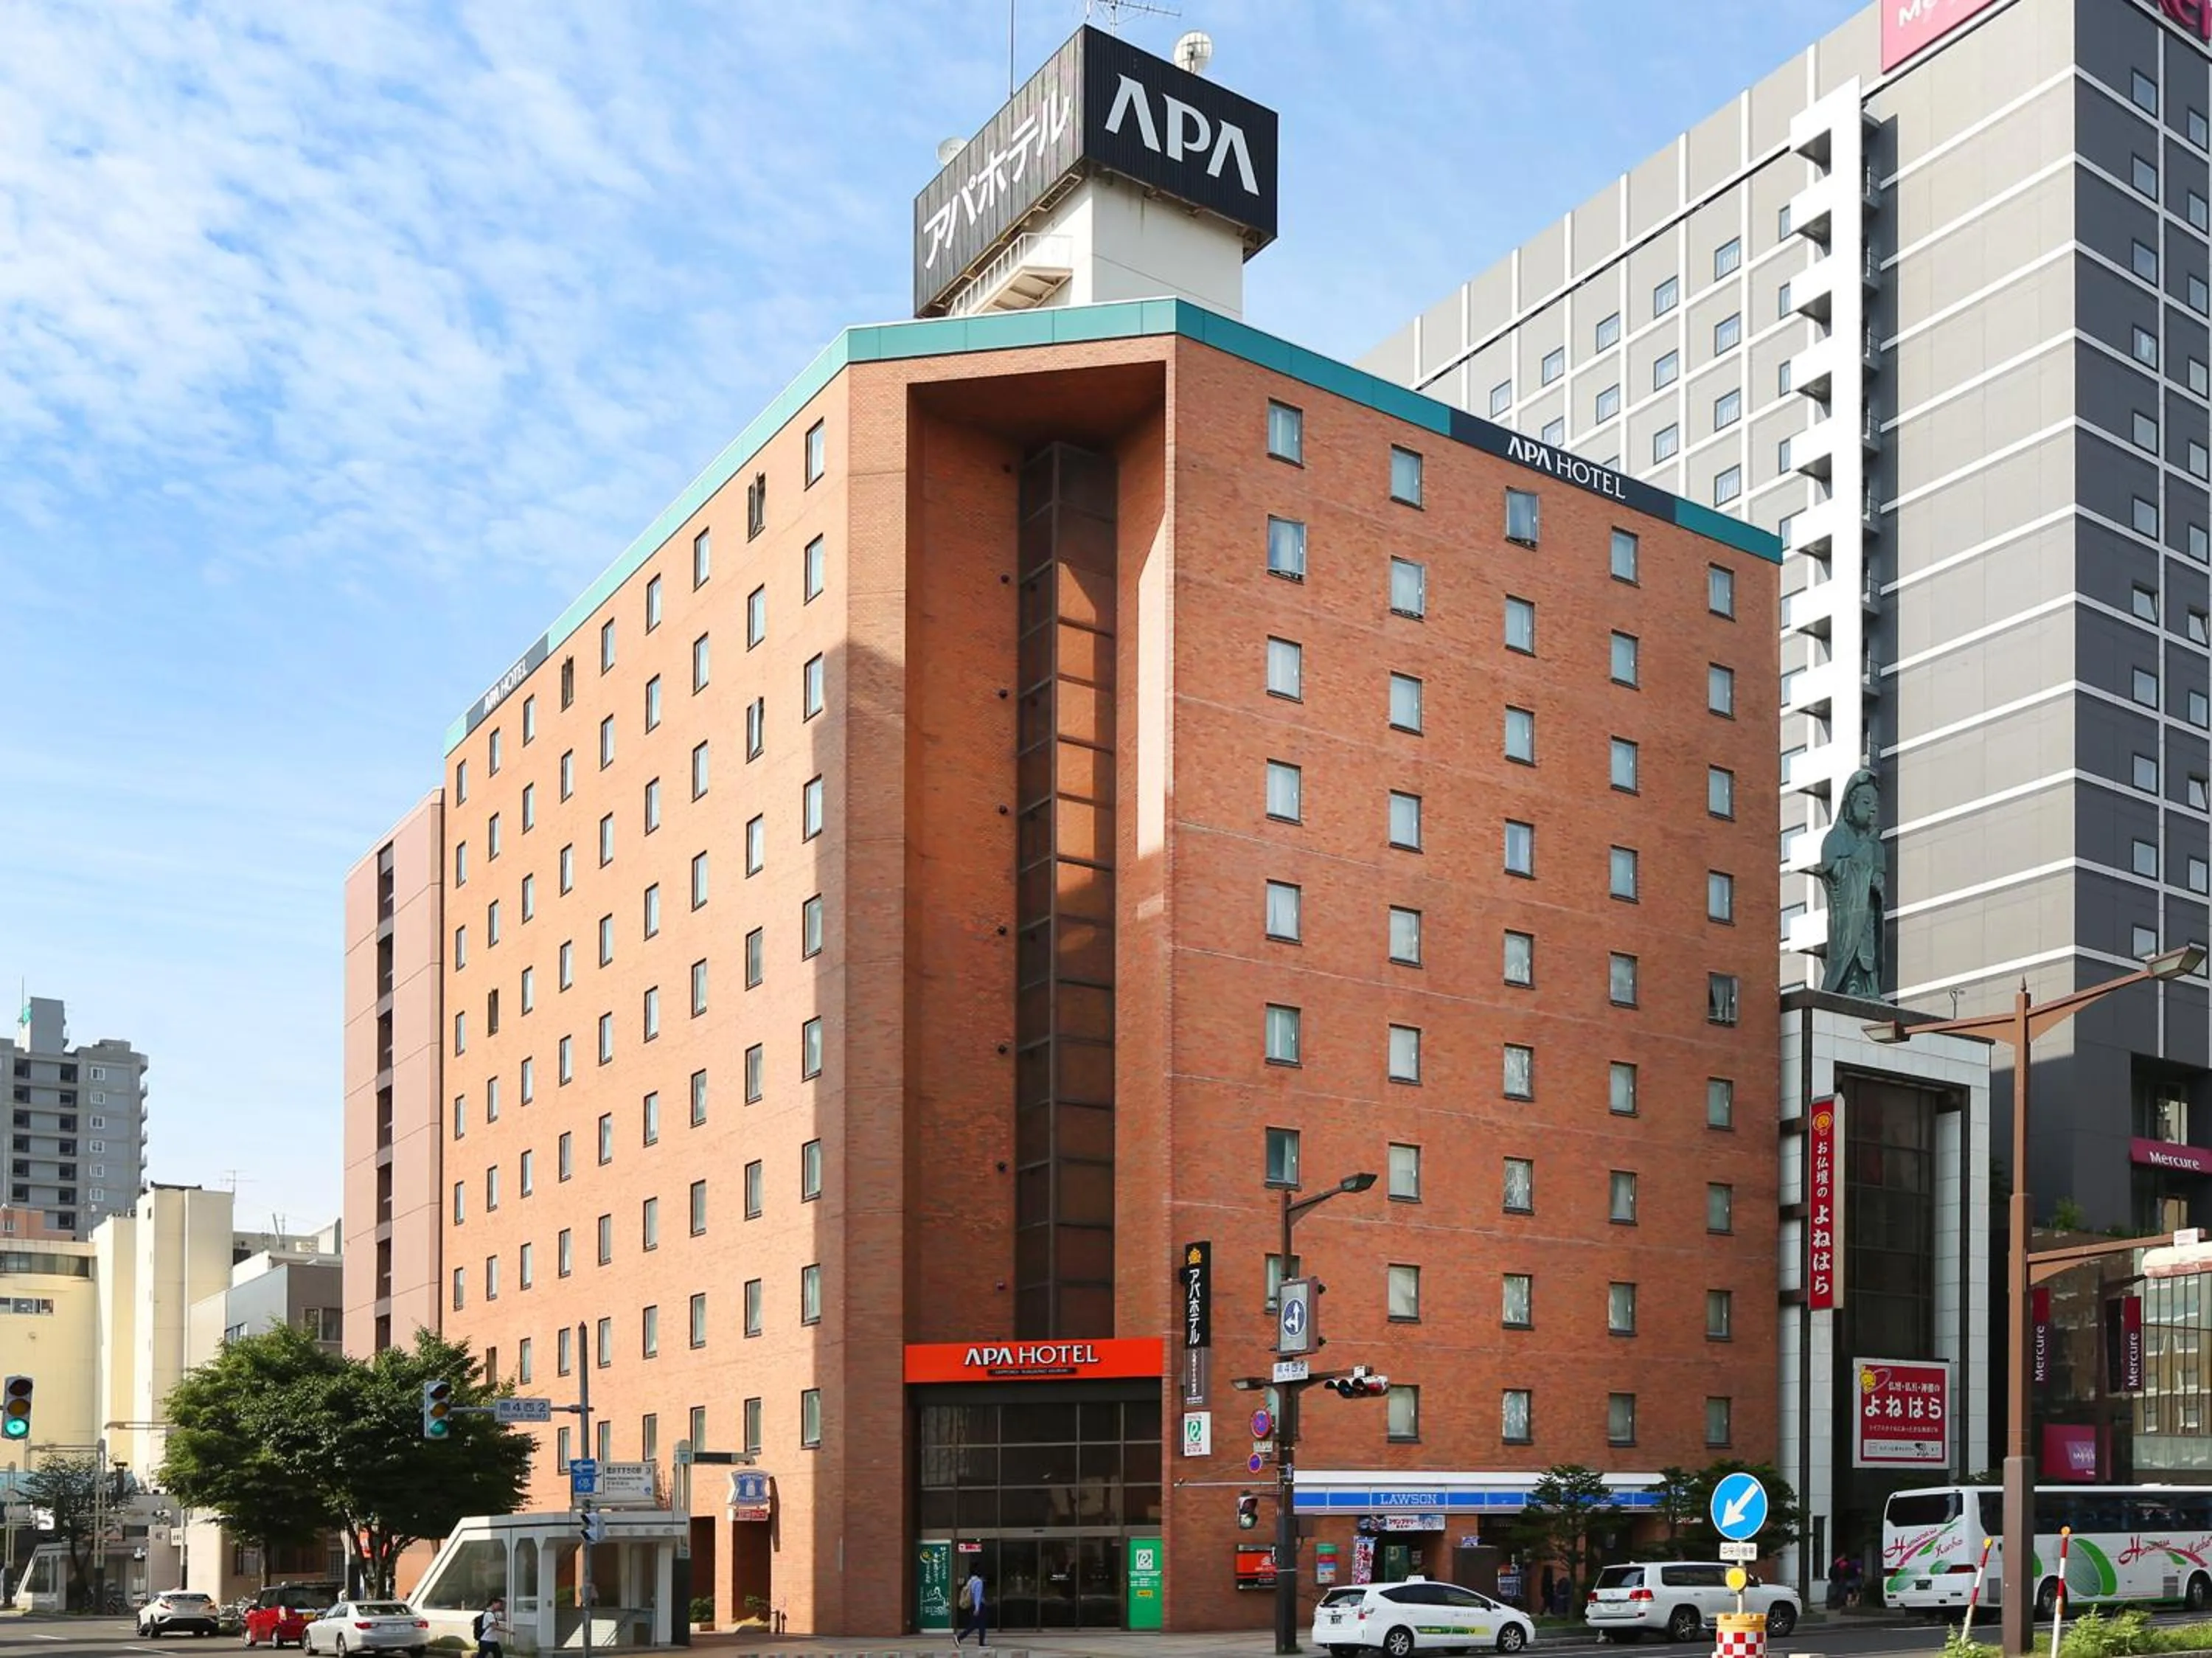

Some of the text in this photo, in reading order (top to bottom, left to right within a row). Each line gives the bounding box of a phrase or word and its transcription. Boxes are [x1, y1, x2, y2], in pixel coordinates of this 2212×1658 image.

[1105, 74, 1259, 195] APA
[923, 90, 1070, 268] アパホテル
[1508, 436, 1626, 499] APA HOTEL
[501, 659, 528, 697] HOTEL
[2149, 1151, 2200, 1170] Mercure
[1812, 1204, 1831, 1296] よねはら
[1189, 1269, 1200, 1345] アパホテル
[964, 1345, 1099, 1365] APA HOTEL
[2035, 1325, 2045, 1382] Mercure
[2128, 1333, 2138, 1387] Mercure
[1865, 1395, 1942, 1420] よねはら
[1380, 1494, 1437, 1505] LAWSON
